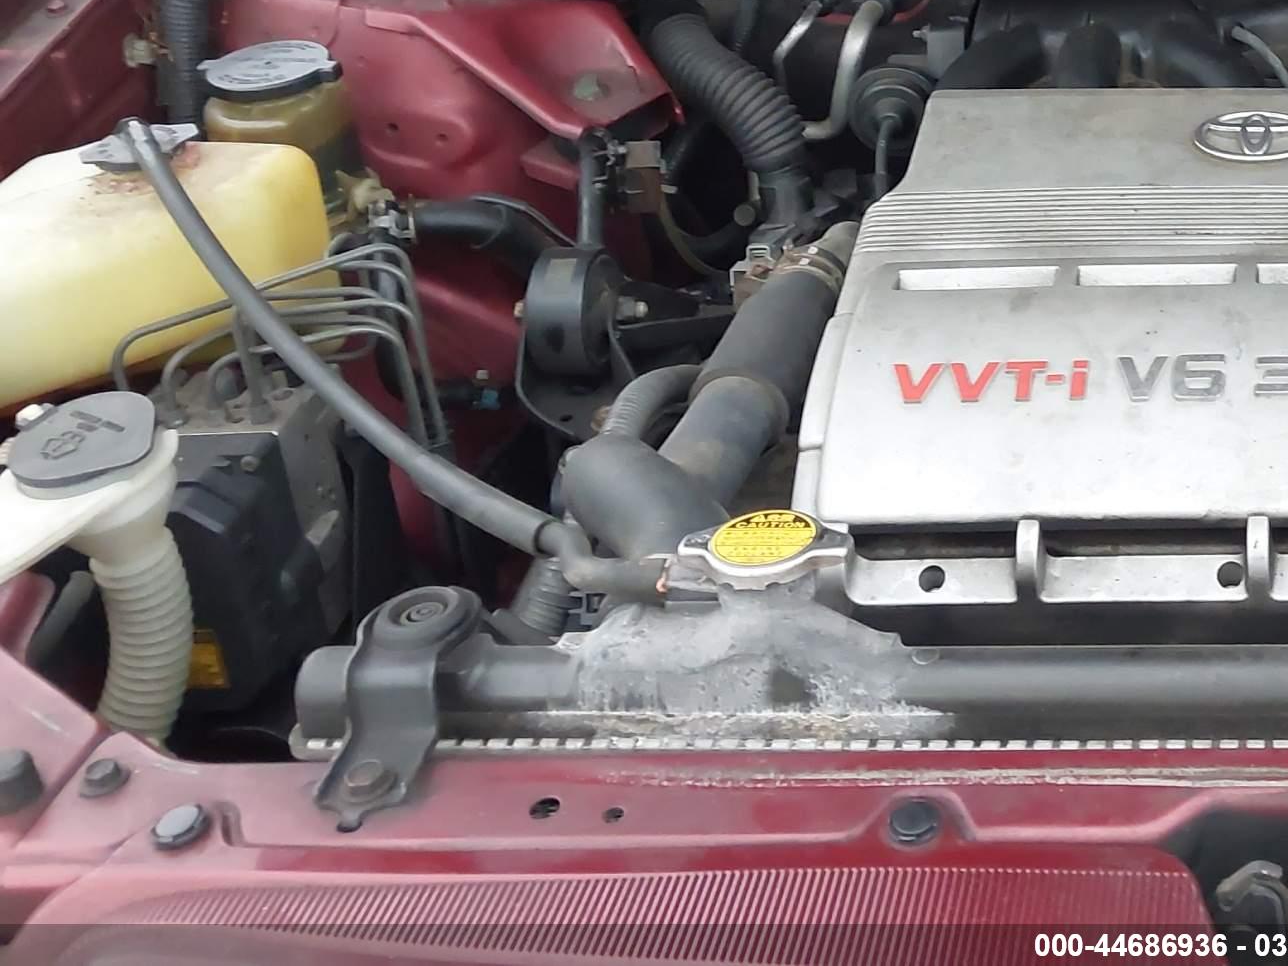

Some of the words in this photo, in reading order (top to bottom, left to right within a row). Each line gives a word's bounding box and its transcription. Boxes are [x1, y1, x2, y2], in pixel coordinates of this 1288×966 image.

[894, 359, 1089, 403] VVT-i
[1117, 354, 1226, 402] V6
[735, 521, 806, 529] CAUTION
